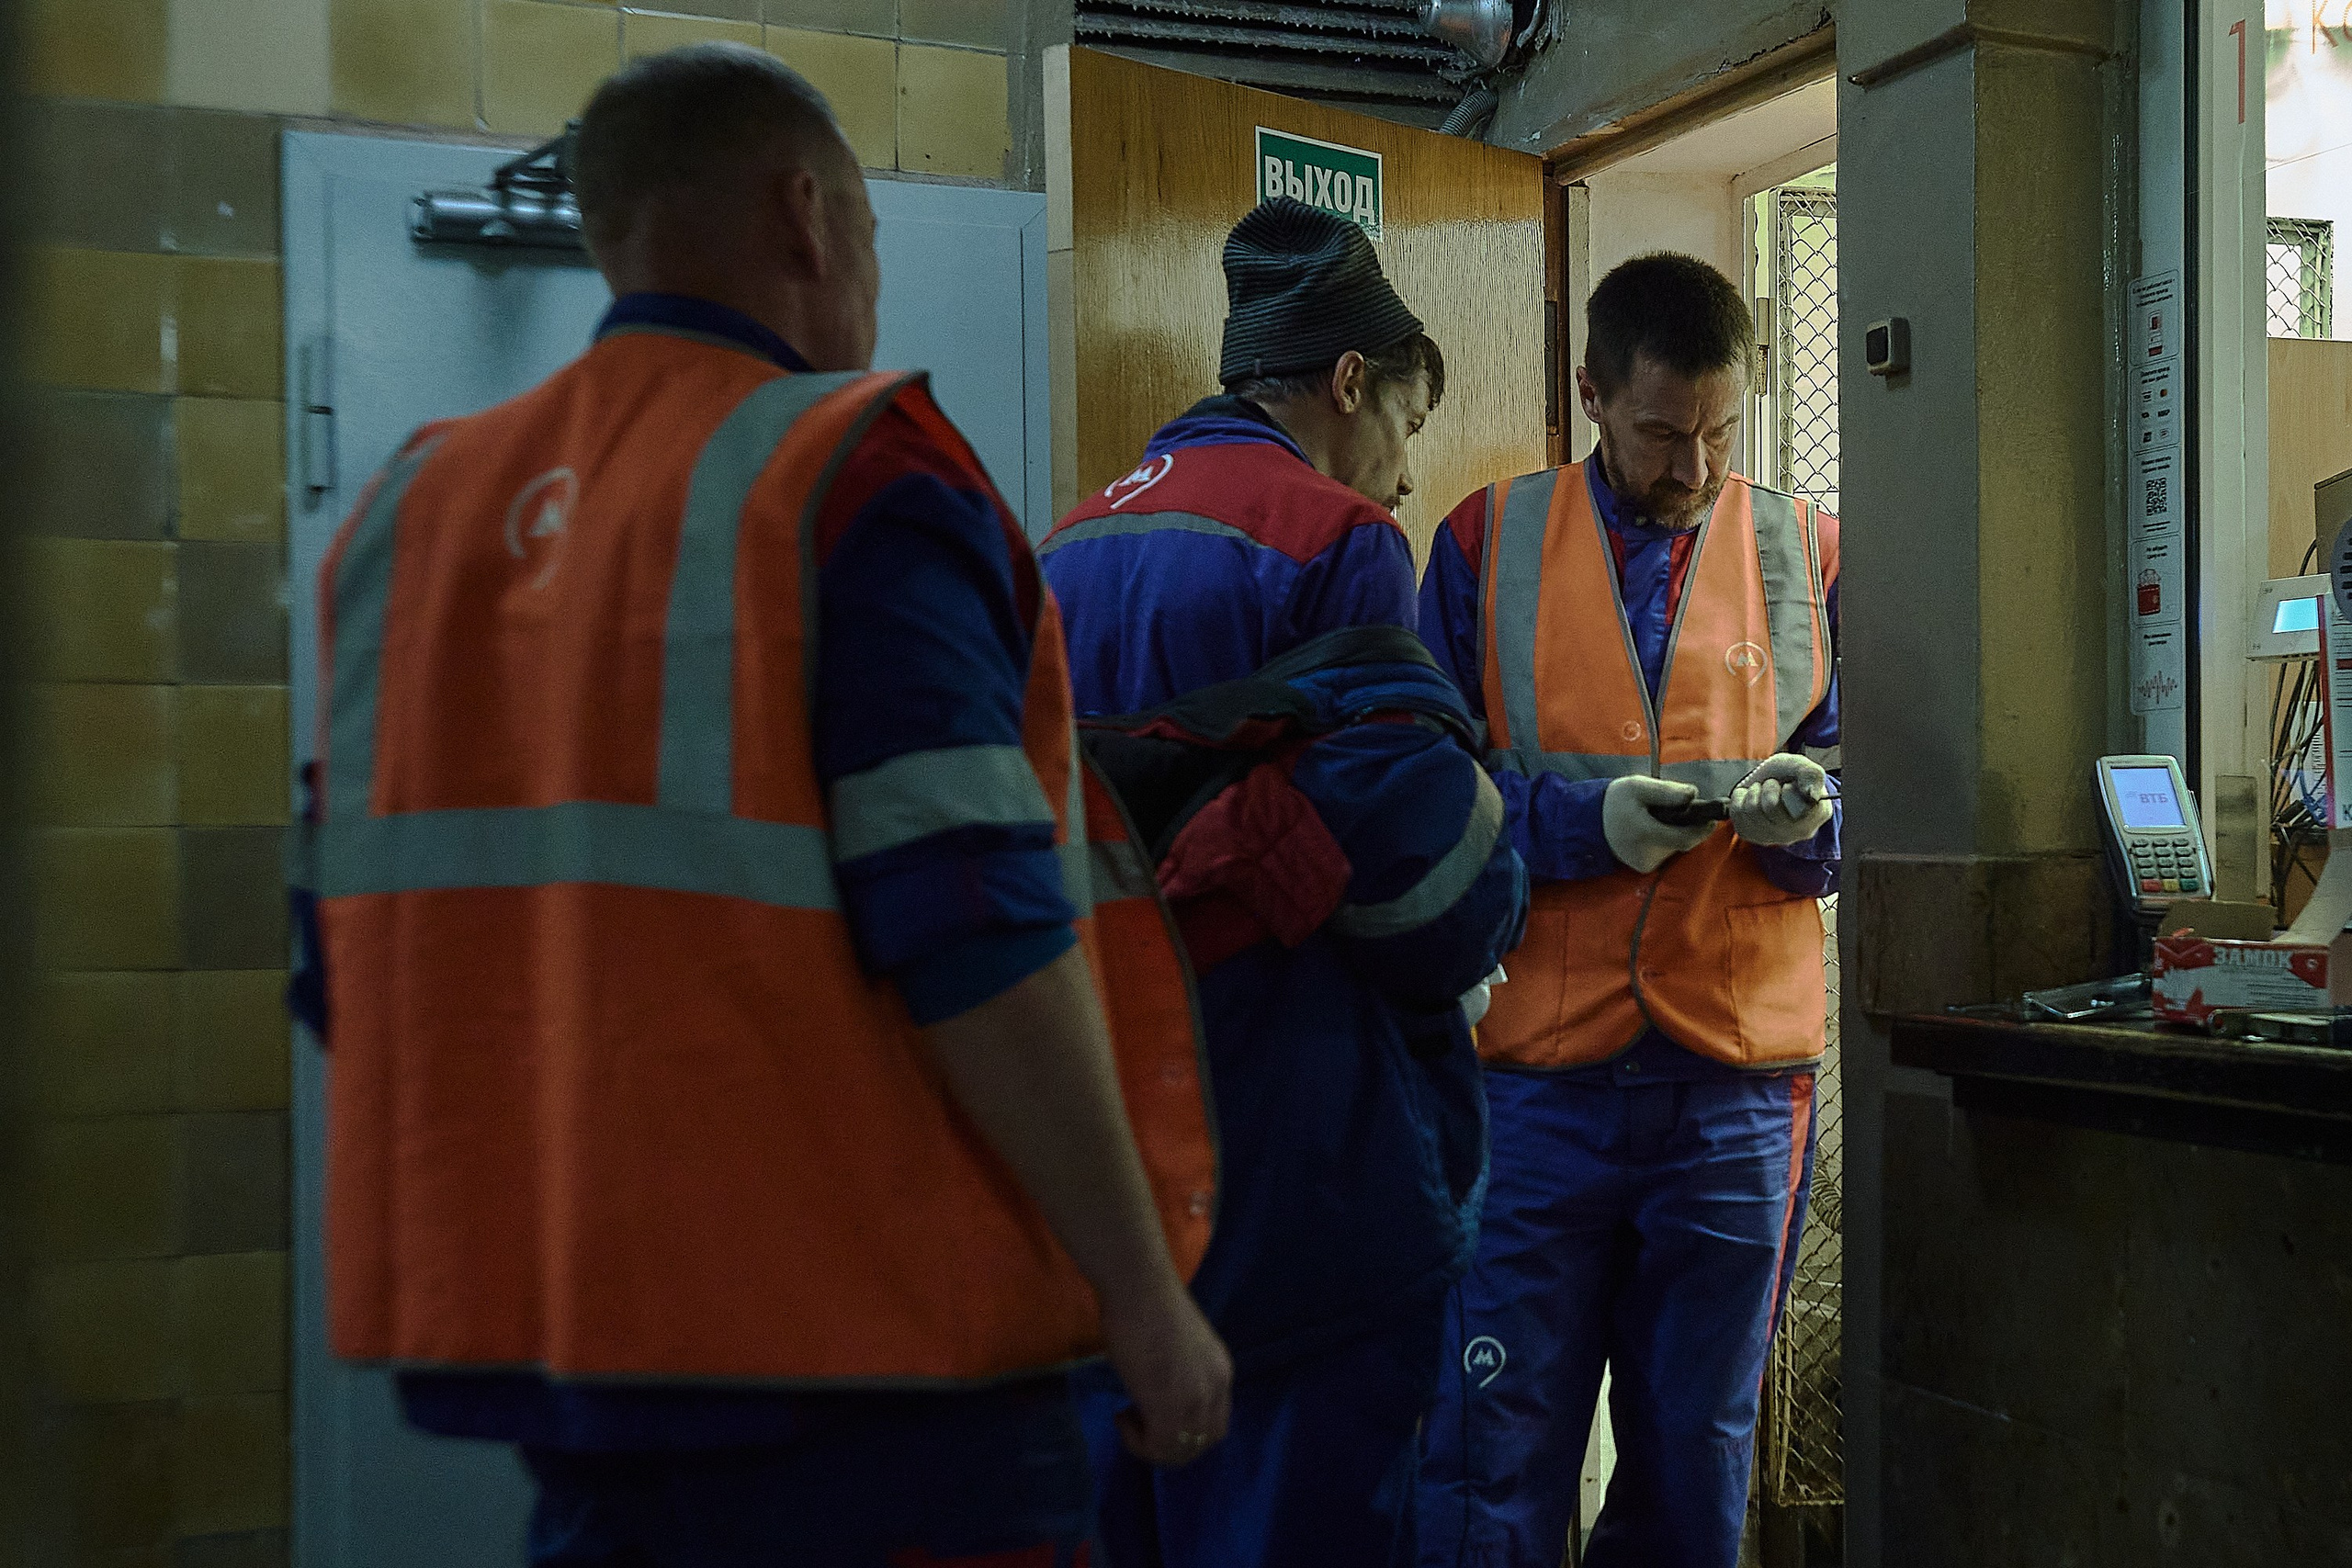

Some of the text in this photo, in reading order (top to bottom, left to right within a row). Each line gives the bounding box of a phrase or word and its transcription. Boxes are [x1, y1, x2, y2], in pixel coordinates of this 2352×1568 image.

[2228, 18, 2246, 124] 1
[1264, 155, 1375, 224] ВЫХОД
[2141, 793, 2168, 804] ВТБ
[2213, 945, 2294, 969] ЗАМОК
